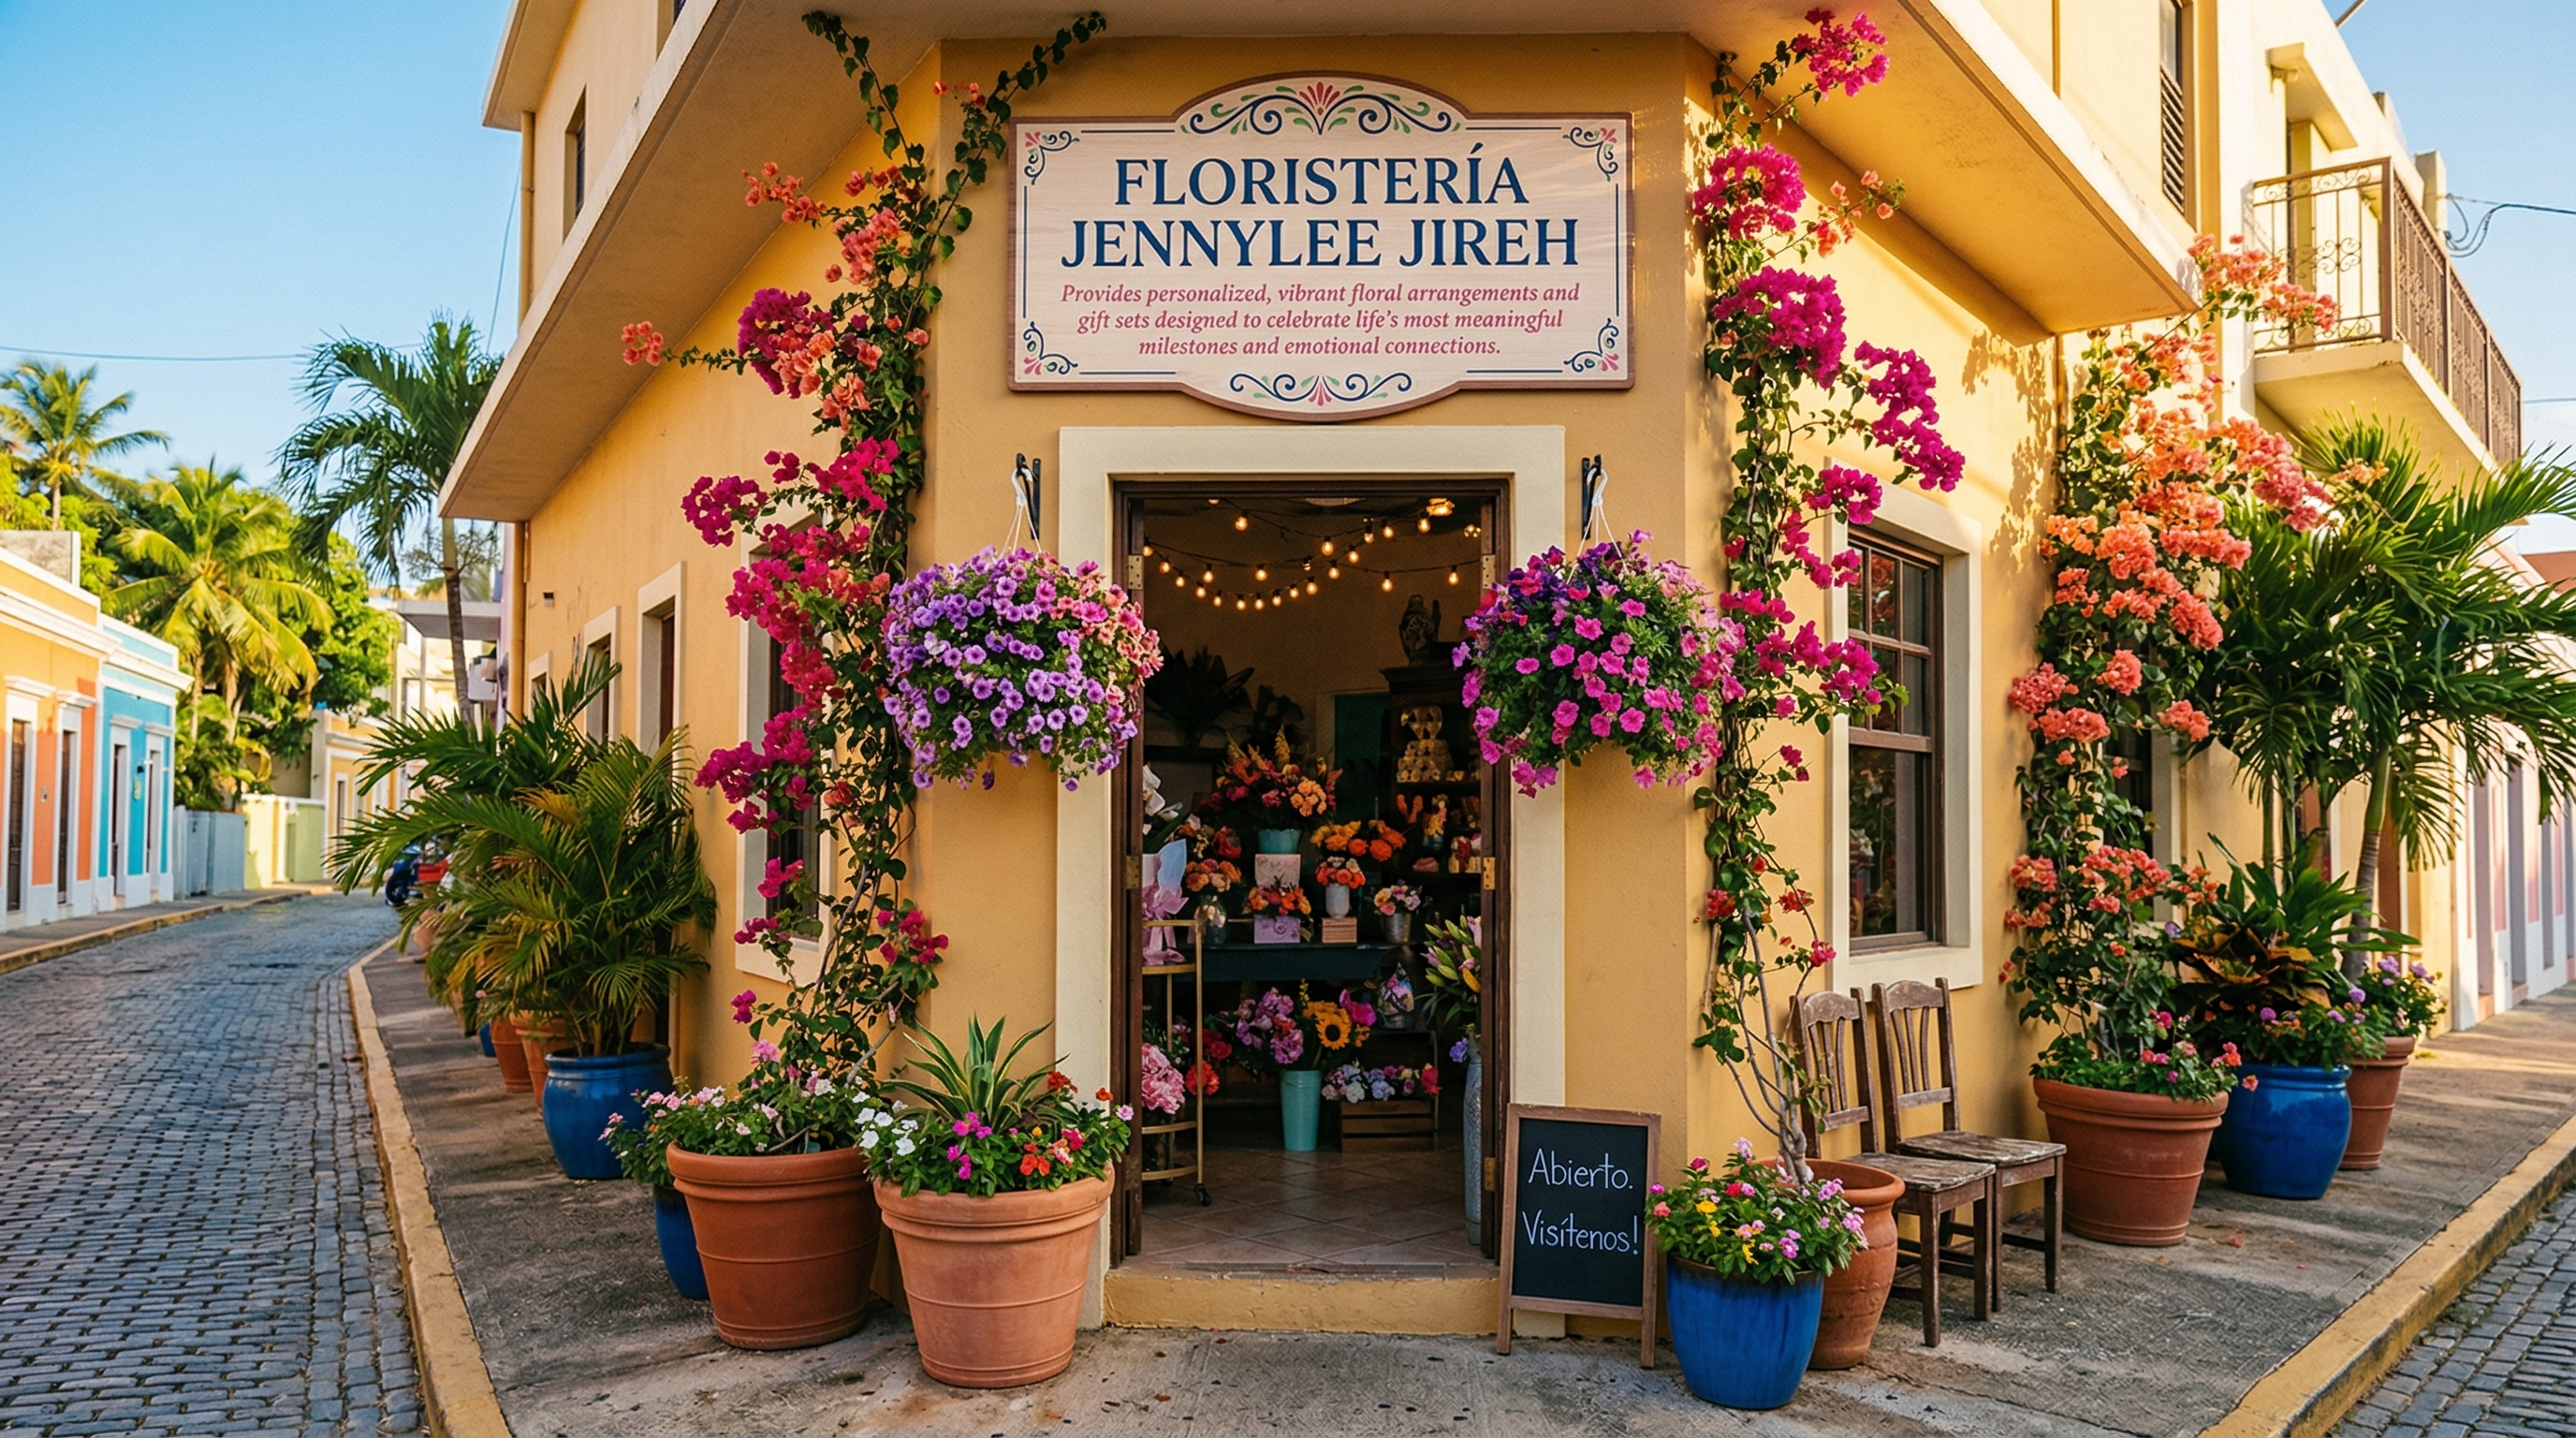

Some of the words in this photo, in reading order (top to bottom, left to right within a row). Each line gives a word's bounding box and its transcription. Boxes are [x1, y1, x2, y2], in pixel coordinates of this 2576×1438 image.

[1116, 142, 1529, 205] FLORISTERÍA
[1061, 220, 1381, 267] JENNYLEE
[1399, 219, 1577, 266] JIREH
[1061, 283, 1141, 302] Provides
[1145, 283, 1271, 307] personalized,
[1279, 284, 1345, 301] vibrant
[1348, 283, 1402, 307] floral
[1407, 286, 1538, 307] arrangements
[1542, 283, 1580, 301] and
[1076, 310, 1111, 334] gift
[1115, 313, 1149, 329] sets
[1155, 311, 1237, 333] designed
[1242, 313, 1262, 329] to
[1266, 310, 1350, 328] celebrate
[1356, 310, 1398, 332] life’s
[1404, 312, 1449, 329] most
[1456, 309, 1563, 333] meaningful
[1138, 336, 1237, 355] milestones
[1243, 337, 1280, 354] and
[1284, 336, 1380, 354] emotional
[1384, 336, 1501, 355] connections.
[1527, 1148, 1633, 1190] Abierto.
[1522, 1210, 1638, 1255] Visítenos!
